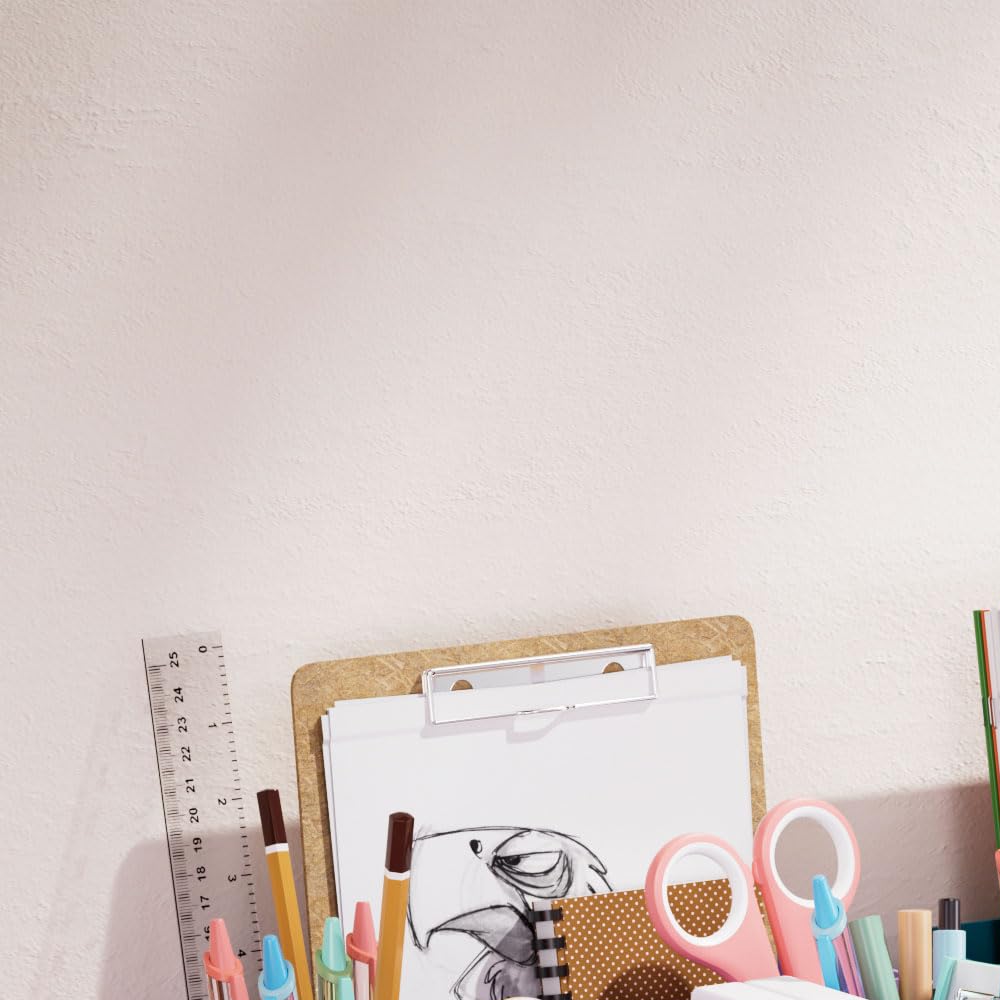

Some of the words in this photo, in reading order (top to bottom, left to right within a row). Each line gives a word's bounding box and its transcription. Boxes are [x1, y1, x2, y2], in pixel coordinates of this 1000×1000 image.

[198, 645, 208, 653] 0
[168, 651, 180, 668] 25
[173, 687, 184, 703] 24
[177, 716, 188, 733] 23
[181, 746, 192, 762] 22
[185, 778, 196, 793] 21
[217, 797, 227, 806] 2
[188, 807, 200, 824] 20
[192, 837, 203, 852] 19
[196, 866, 207, 881] 18
[227, 874, 237, 882] 3
[200, 895, 211, 910] 17
[237, 949, 247, 958] 4
